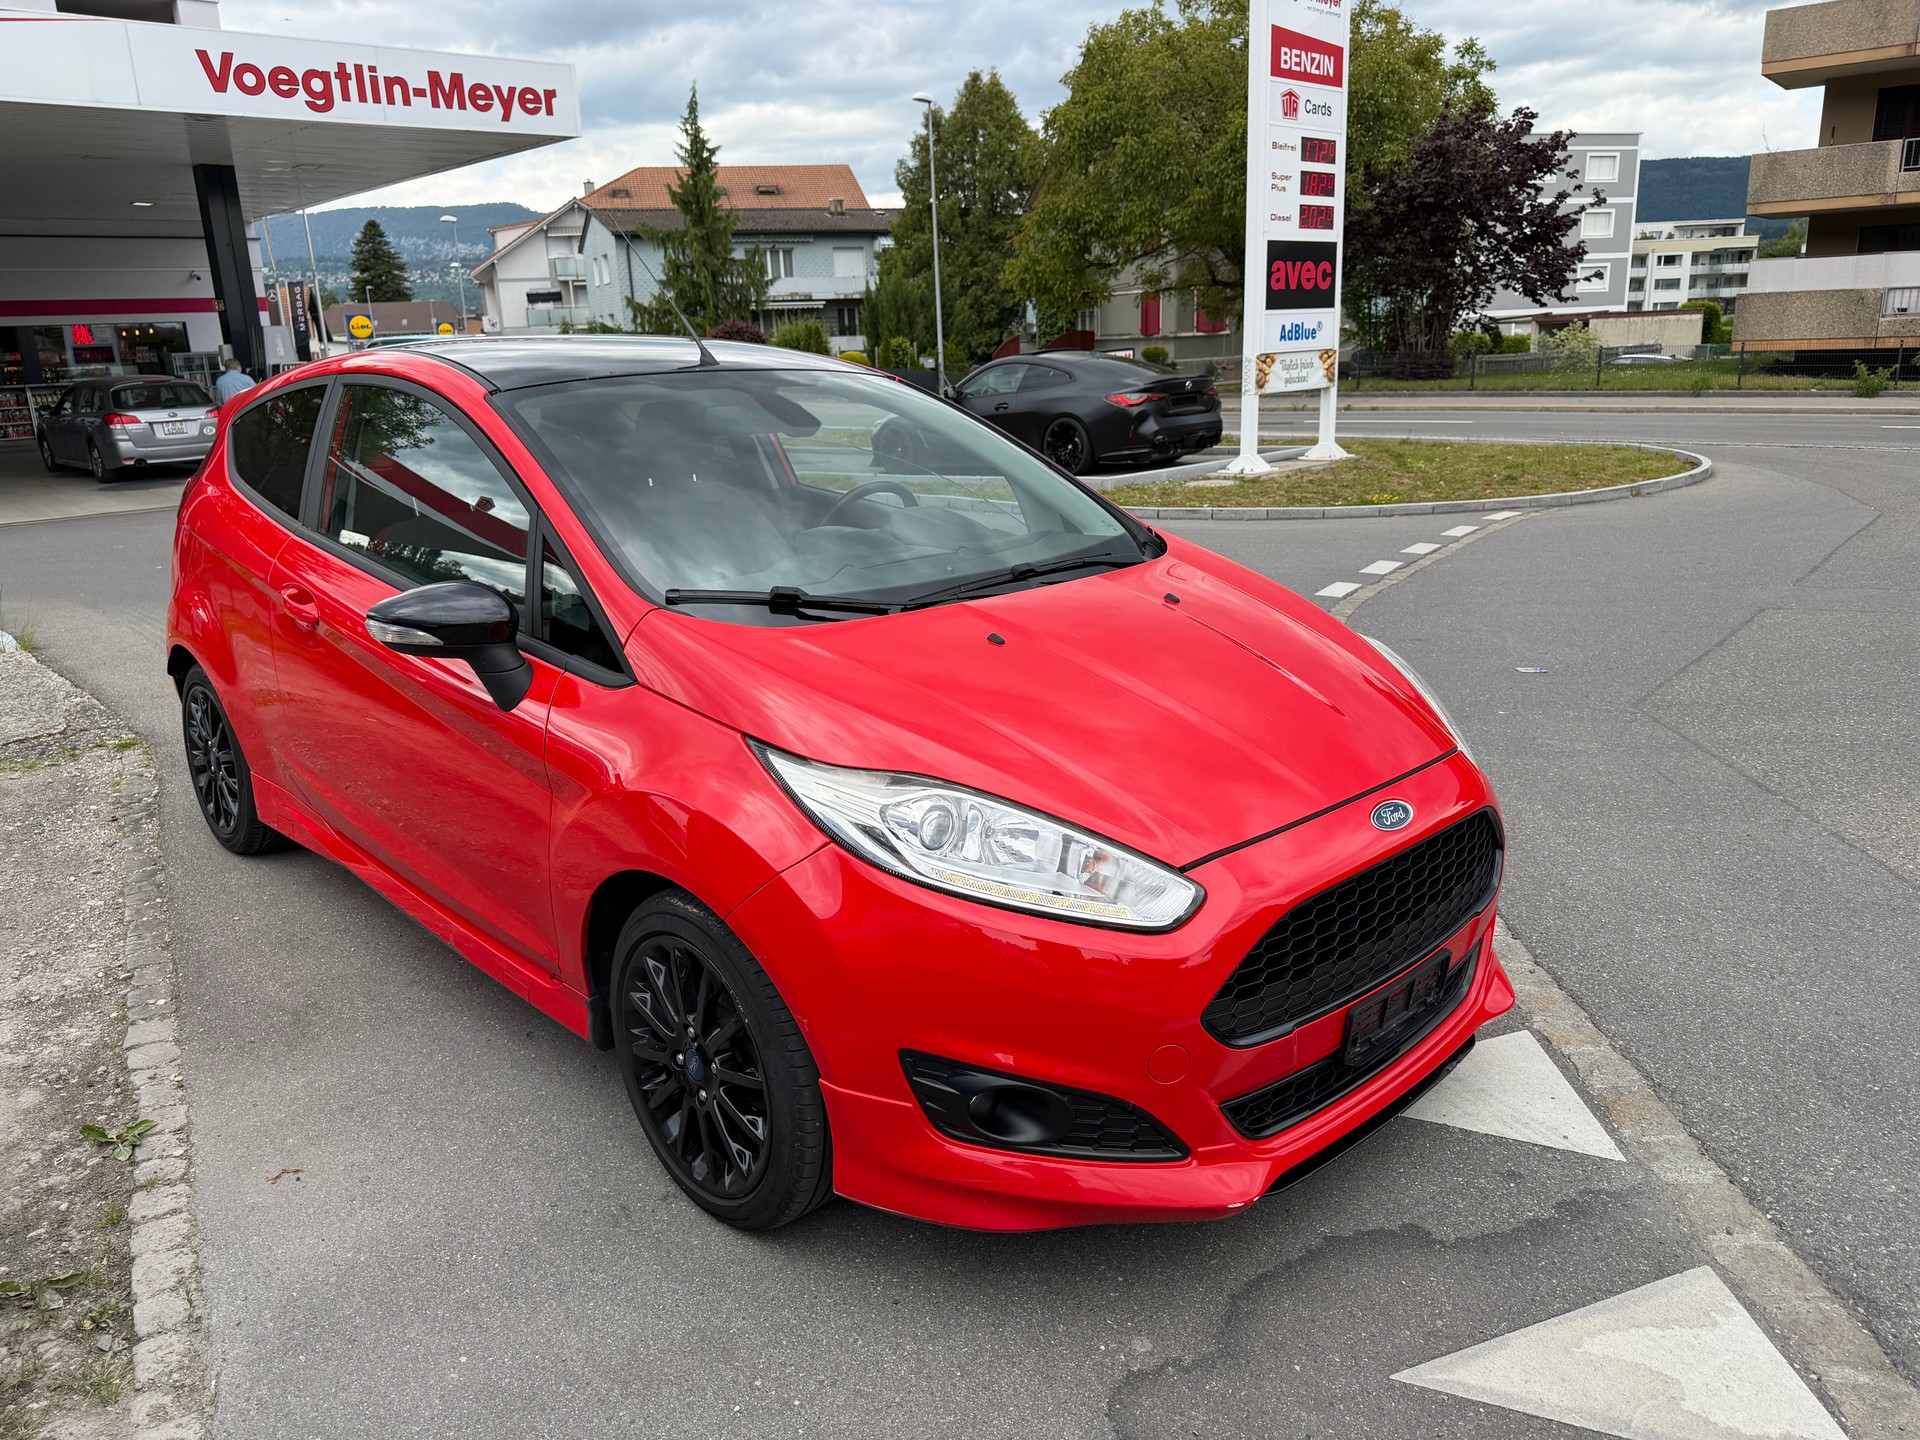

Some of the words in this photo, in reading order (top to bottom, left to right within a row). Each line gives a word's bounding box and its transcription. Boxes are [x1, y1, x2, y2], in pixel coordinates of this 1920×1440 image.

[1280, 46, 1334, 77] BENZIN
[194, 48, 557, 122] Voegtlin-Meyer
[1304, 99, 1332, 117] Cards
[1271, 141, 1297, 152] Bleifrei
[1271, 171, 1293, 182] Super
[1271, 183, 1287, 193] Plus
[1270, 213, 1292, 222] Diesel
[1270, 260, 1333, 290] avec
[293, 285, 306, 332] MERBAG
[1380, 806, 1406, 825] Ford
